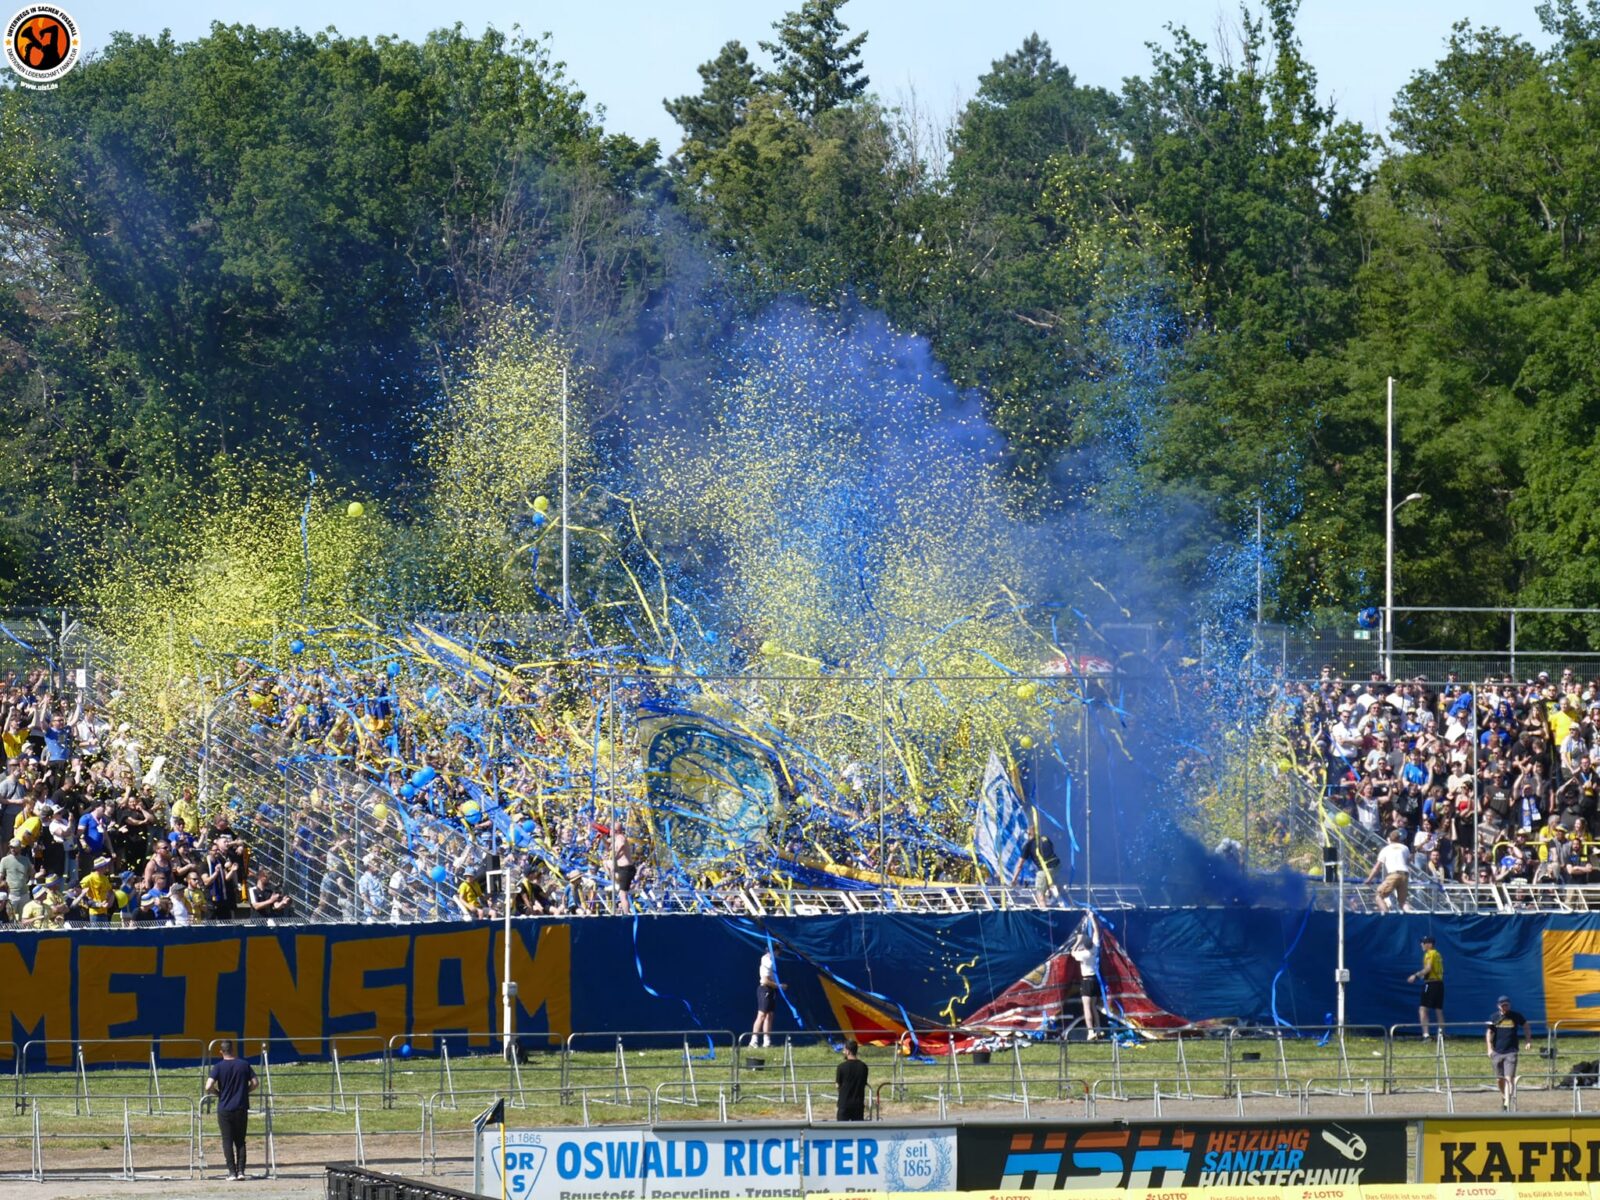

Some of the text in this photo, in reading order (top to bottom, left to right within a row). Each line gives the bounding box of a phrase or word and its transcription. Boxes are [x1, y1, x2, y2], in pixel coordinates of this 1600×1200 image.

[518, 1133, 541, 1143] 1865
[1206, 1129, 1311, 1152] HEIZUNG
[906, 1141, 927, 1157] seit
[1201, 1143, 1304, 1173] SANITÄR
[556, 1138, 879, 1180] OSWALD RICHTER
[903, 1159, 932, 1177] 1865
[1199, 1168, 1364, 1187] HAUSTECHNIK
[1314, 1191, 1344, 1199] LOTTO
[1467, 1188, 1496, 1196] LOTTO
